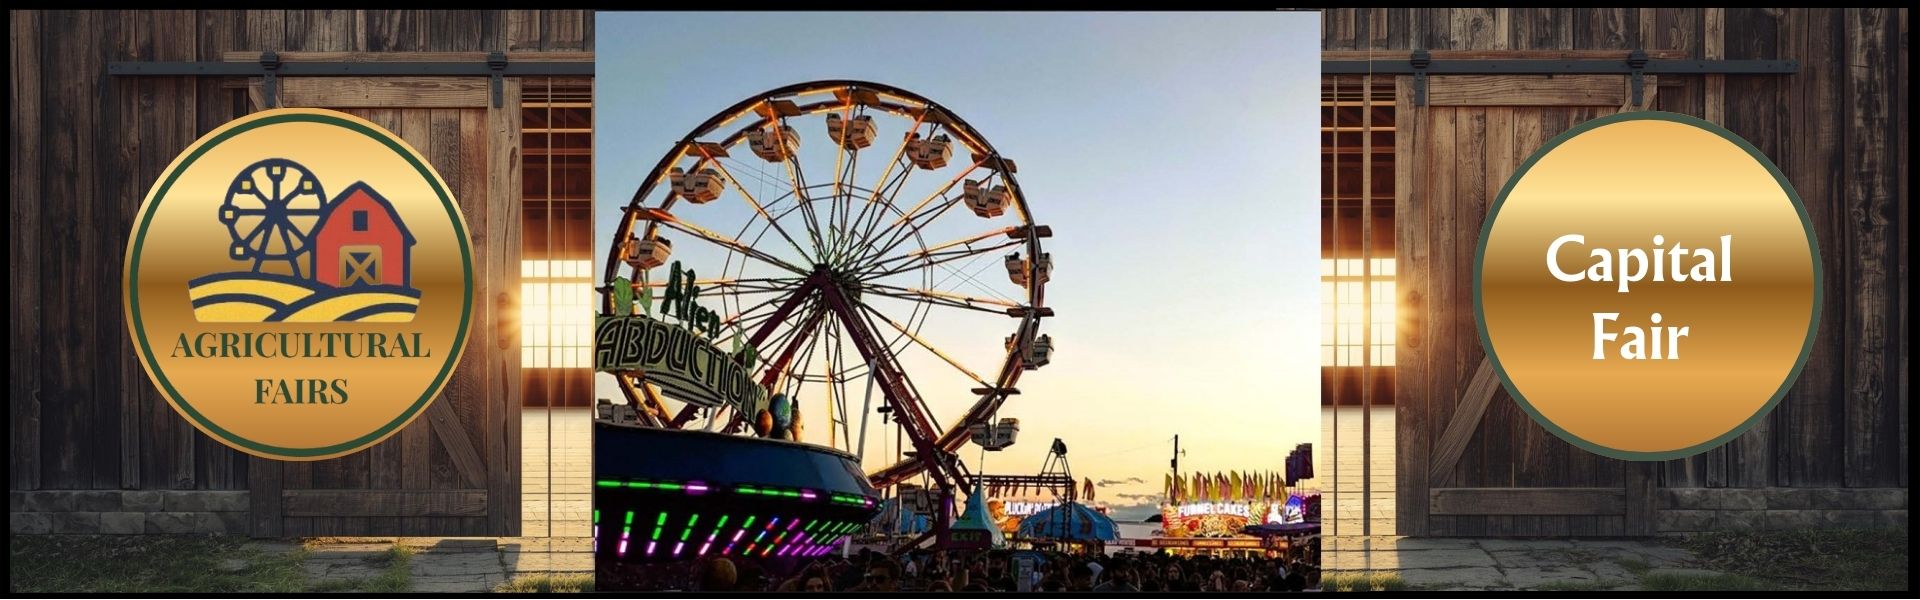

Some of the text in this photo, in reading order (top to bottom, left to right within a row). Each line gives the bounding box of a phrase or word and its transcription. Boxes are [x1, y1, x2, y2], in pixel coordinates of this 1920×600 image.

[660, 260, 720, 340] Alien
[595, 316, 758, 424] ABDUCTION
[1217, 503, 1250, 518] CAKES
[951, 531, 983, 541] EXIT
